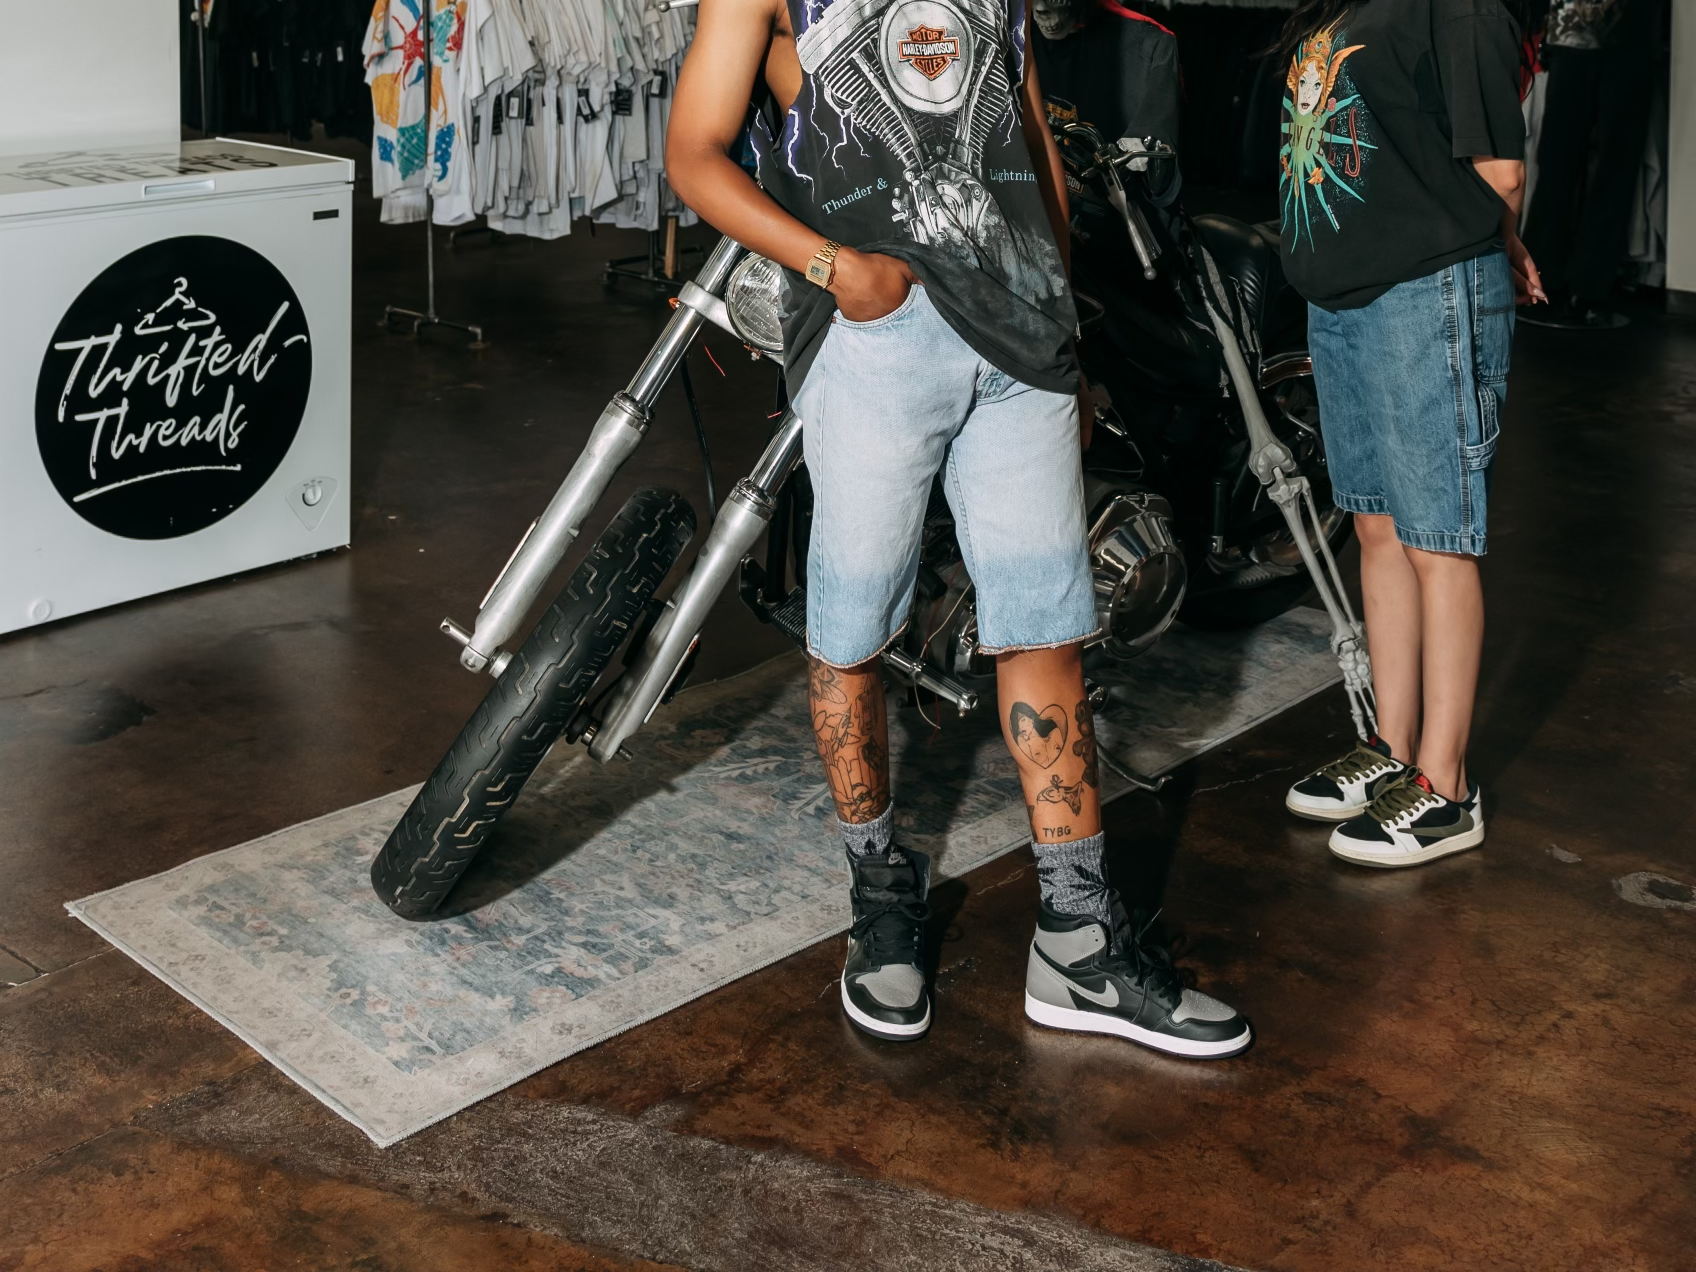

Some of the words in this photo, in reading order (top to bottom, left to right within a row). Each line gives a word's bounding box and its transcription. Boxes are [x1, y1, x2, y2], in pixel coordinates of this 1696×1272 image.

[902, 41, 956, 56] HARLEY-DAVIDSON
[911, 28, 940, 41] MOTOR
[822, 185, 873, 215] Thunder
[876, 177, 889, 191] &
[988, 168, 1038, 184] Lightnin
[54, 301, 300, 423] Thrifted
[74, 383, 248, 481] Threads
[1042, 825, 1072, 838] TYBG
